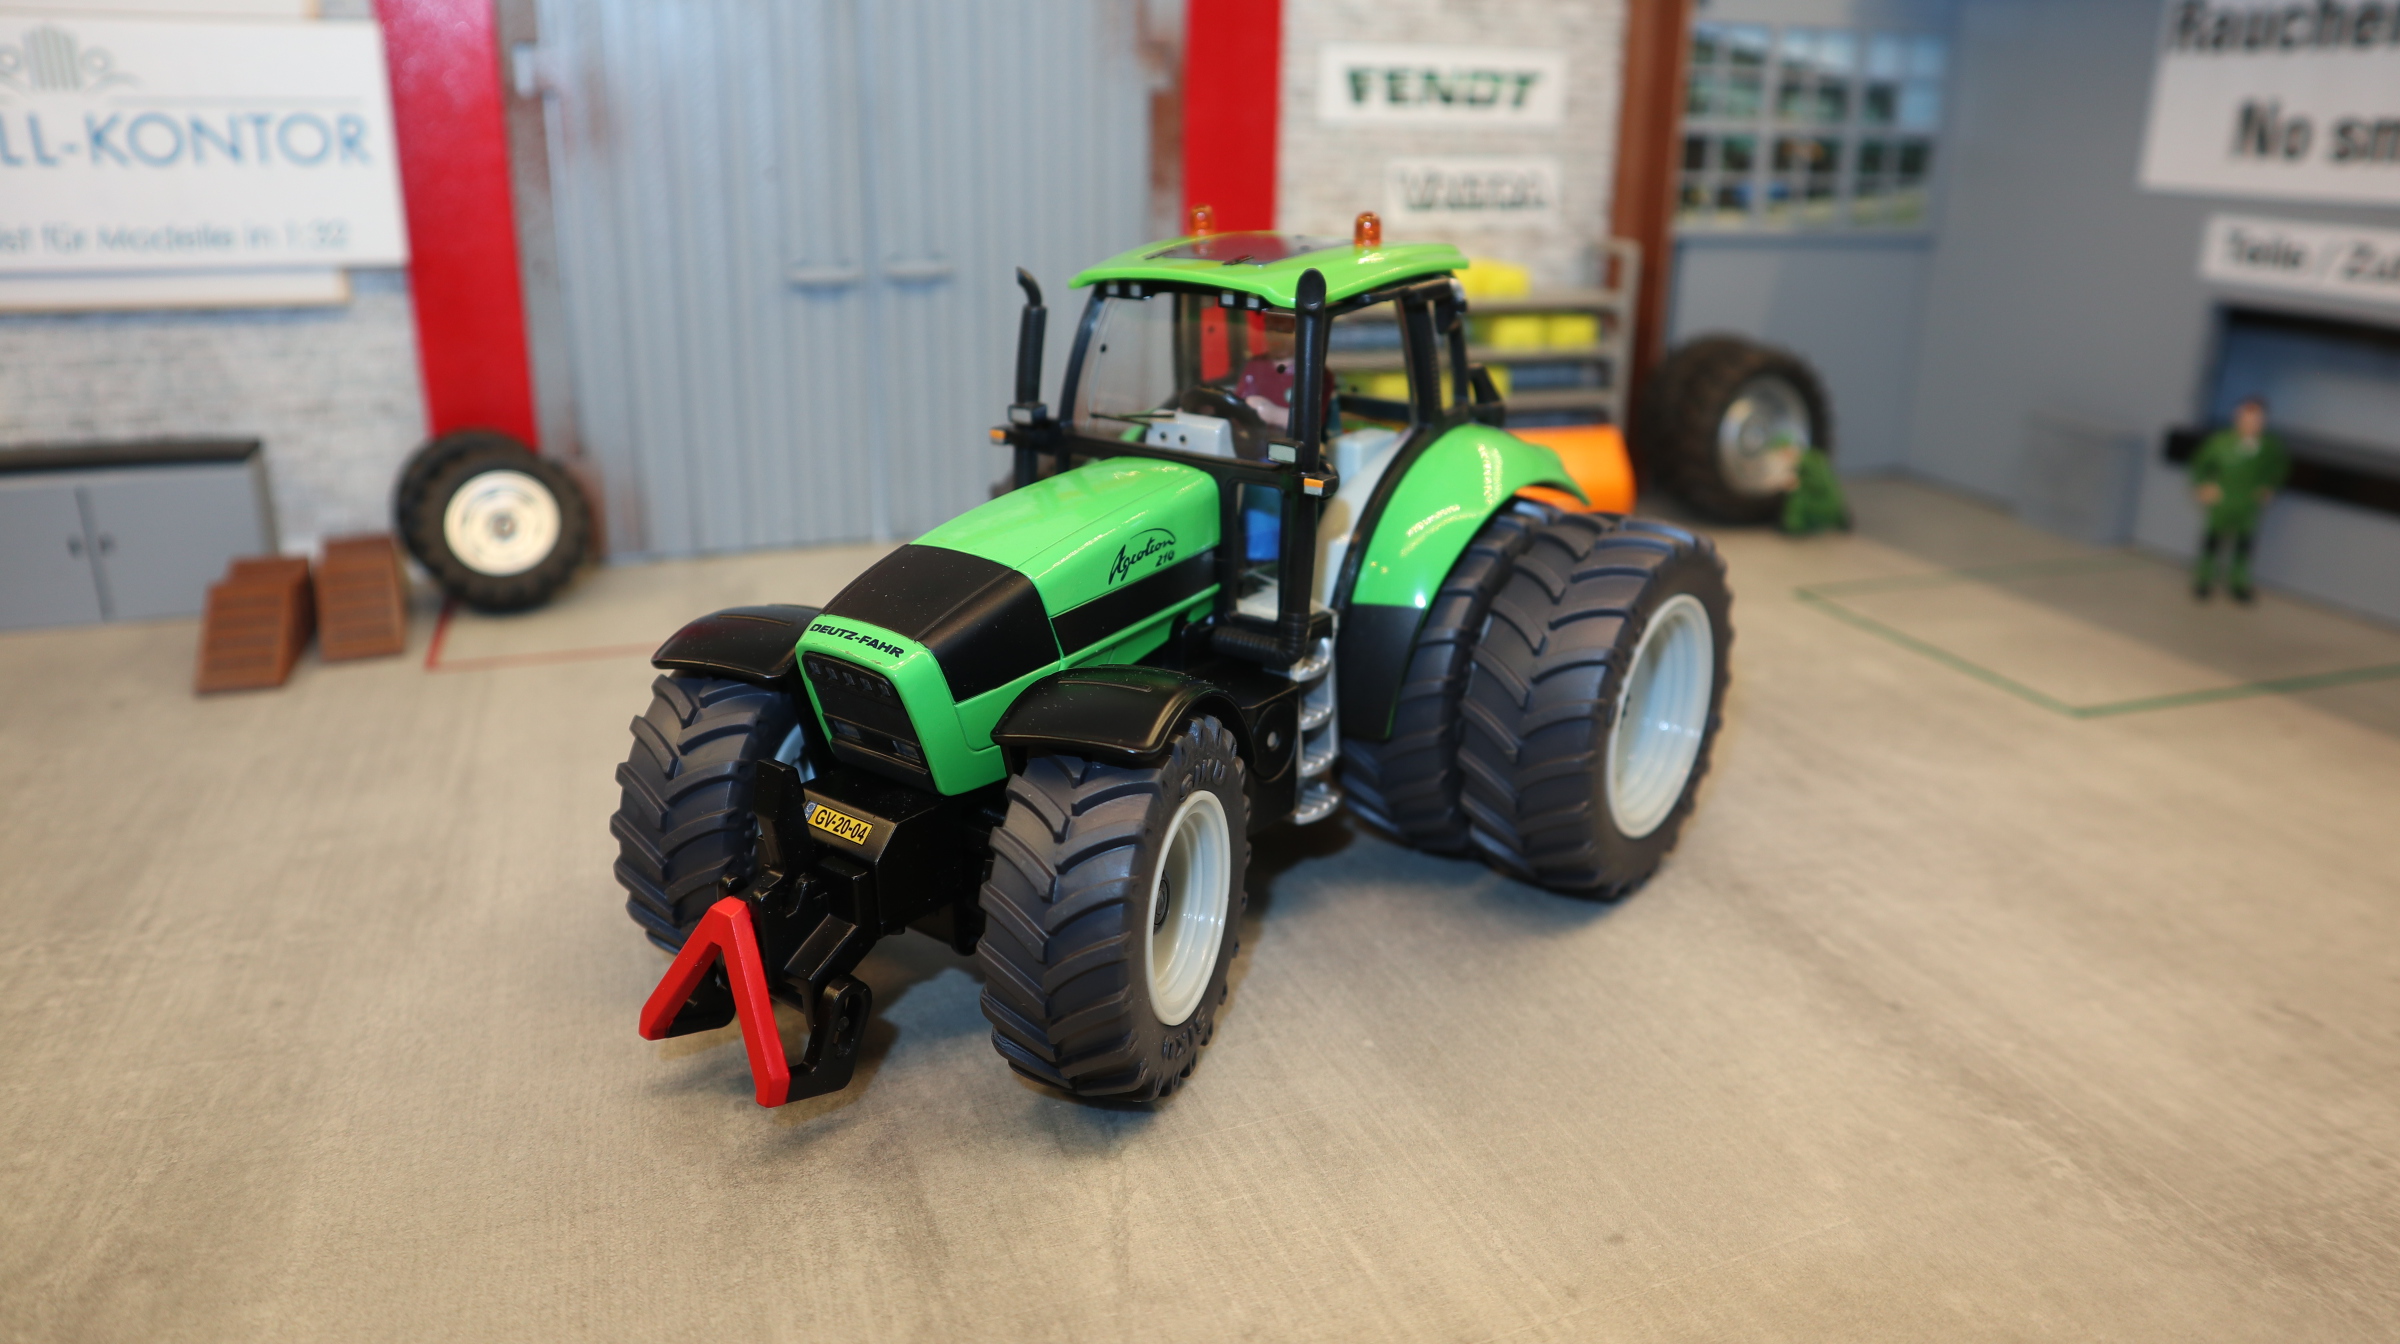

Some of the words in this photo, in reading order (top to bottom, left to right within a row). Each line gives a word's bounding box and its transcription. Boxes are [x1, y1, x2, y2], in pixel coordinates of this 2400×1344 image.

[1344, 66, 1541, 107] FENDT
[2231, 99, 2312, 160] No
[1155, 549, 1175, 568] 210
[809, 623, 905, 658] DEUTZ-FAHR
[815, 809, 868, 842] GV-20-04
